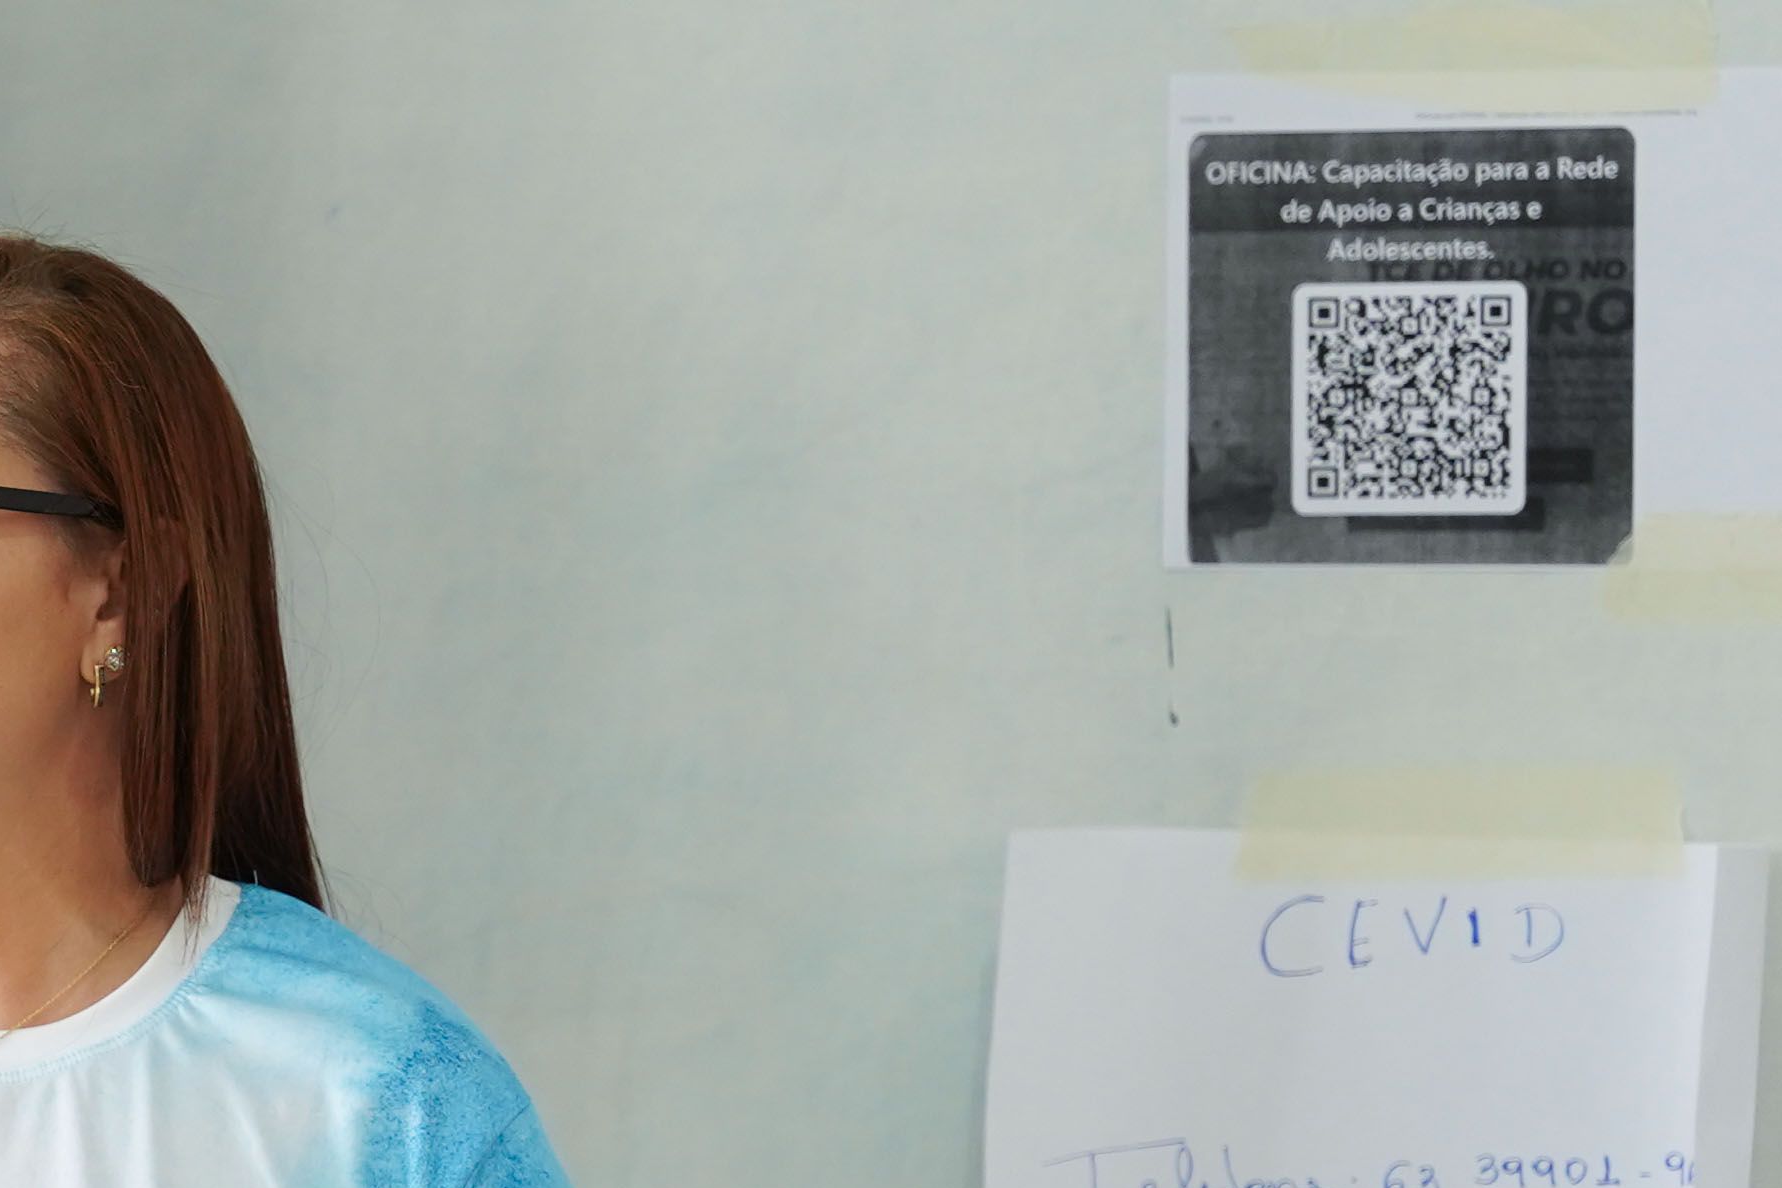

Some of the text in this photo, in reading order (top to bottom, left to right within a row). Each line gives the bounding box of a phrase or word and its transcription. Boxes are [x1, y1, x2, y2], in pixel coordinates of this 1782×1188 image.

[1205, 155, 1619, 188] OFICINA: Capacitação para a Rede
[1280, 197, 1543, 228] de Apoio a Crianças e
[1325, 236, 1496, 262] Adolescentes.
[1580, 259, 1628, 281] NO
[1260, 893, 1565, 978] CEVID
